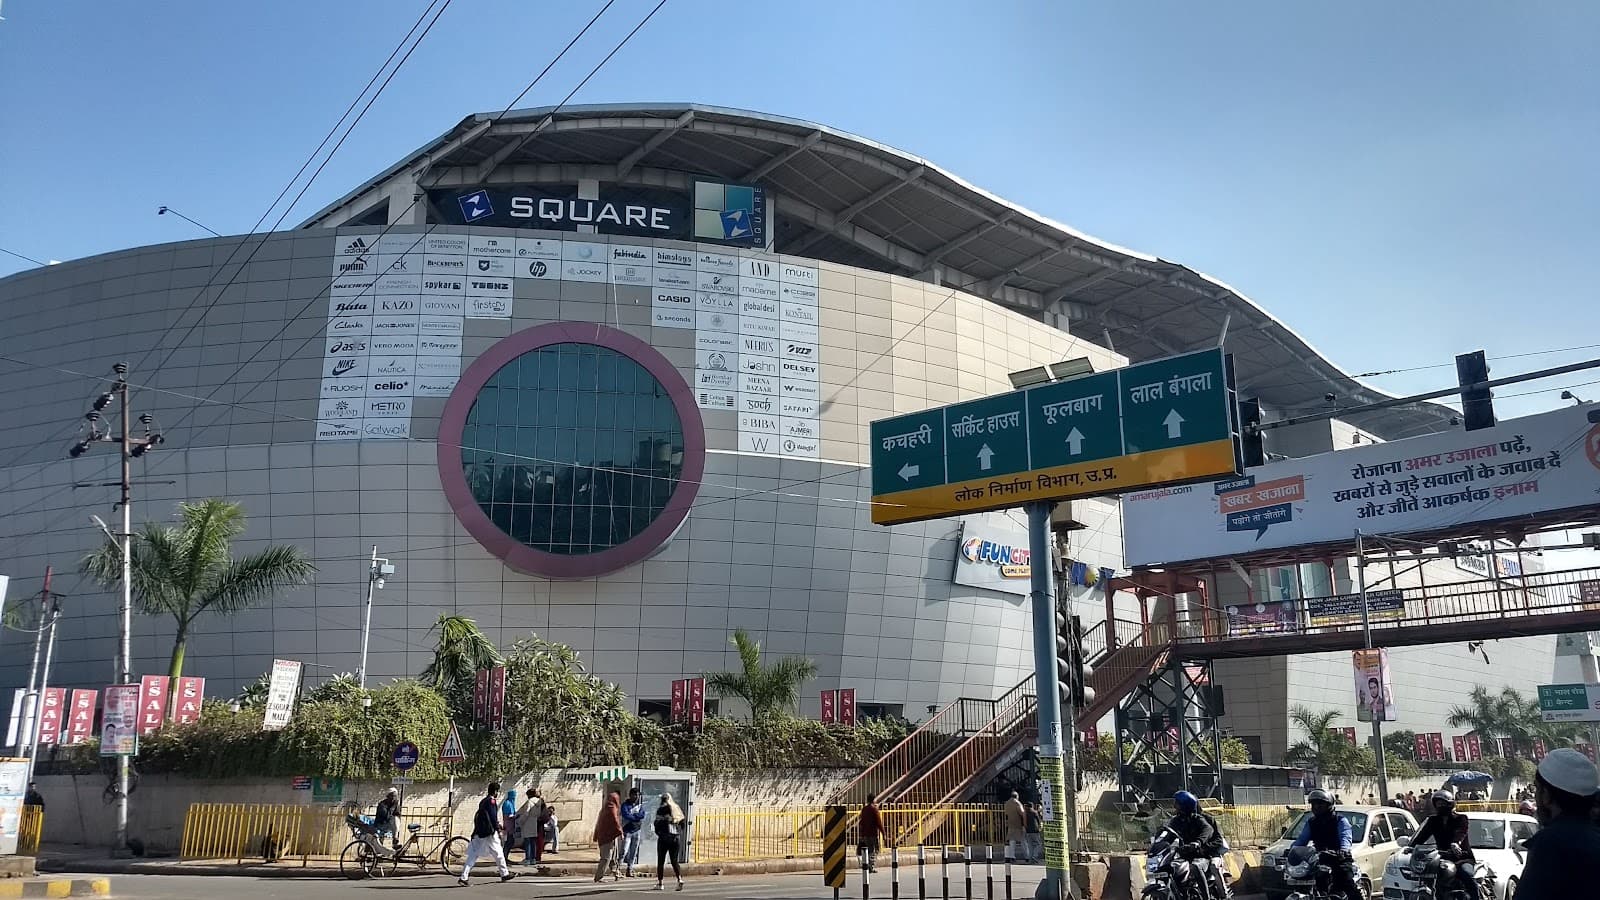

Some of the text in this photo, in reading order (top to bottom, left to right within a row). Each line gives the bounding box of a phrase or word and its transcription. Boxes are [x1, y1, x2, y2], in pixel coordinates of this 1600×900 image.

[509, 196, 671, 230] SQUARE
[753, 186, 762, 245] SQUARE
[530, 261, 546, 277] hp
[425, 281, 452, 289] spykar
[382, 301, 414, 310] KAZO
[425, 302, 460, 310] GIOVANI
[658, 294, 691, 304] CASIO
[700, 297, 734, 307] VOYLLA
[335, 303, 368, 311] Bata
[334, 321, 364, 329] Clarks
[337, 359, 356, 369] NIKE
[743, 359, 776, 373] Jashn
[783, 363, 816, 373] DELSEY
[748, 377, 770, 385] MEENA
[1130, 371, 1213, 404] लाल बंगला
[746, 385, 772, 393] BAZAAR
[371, 402, 406, 411] METRO
[1042, 392, 1104, 425] फूलबाग
[750, 418, 776, 430] BIBA
[951, 410, 1021, 439] सर्किट हाउस
[751, 437, 768, 452] W
[882, 424, 933, 452] कचहरी
[1351, 463, 1402, 480] रोजाना
[1405, 453, 1442, 471] अमर
[1444, 443, 1498, 464] उजाला
[1332, 450, 1561, 503] खबरों से जुड़े सवालों के जवाब दें
[954, 486, 984, 502] लोक
[987, 477, 1033, 499] निर्माण
[1129, 485, 1192, 503] amarujala.com
[1356, 480, 1539, 519] और जीतें आकर्षक इनाम
[980, 540, 1030, 565] FUN CIT
[181, 688, 196, 724] SAL
[40, 698, 58, 743] SALE
